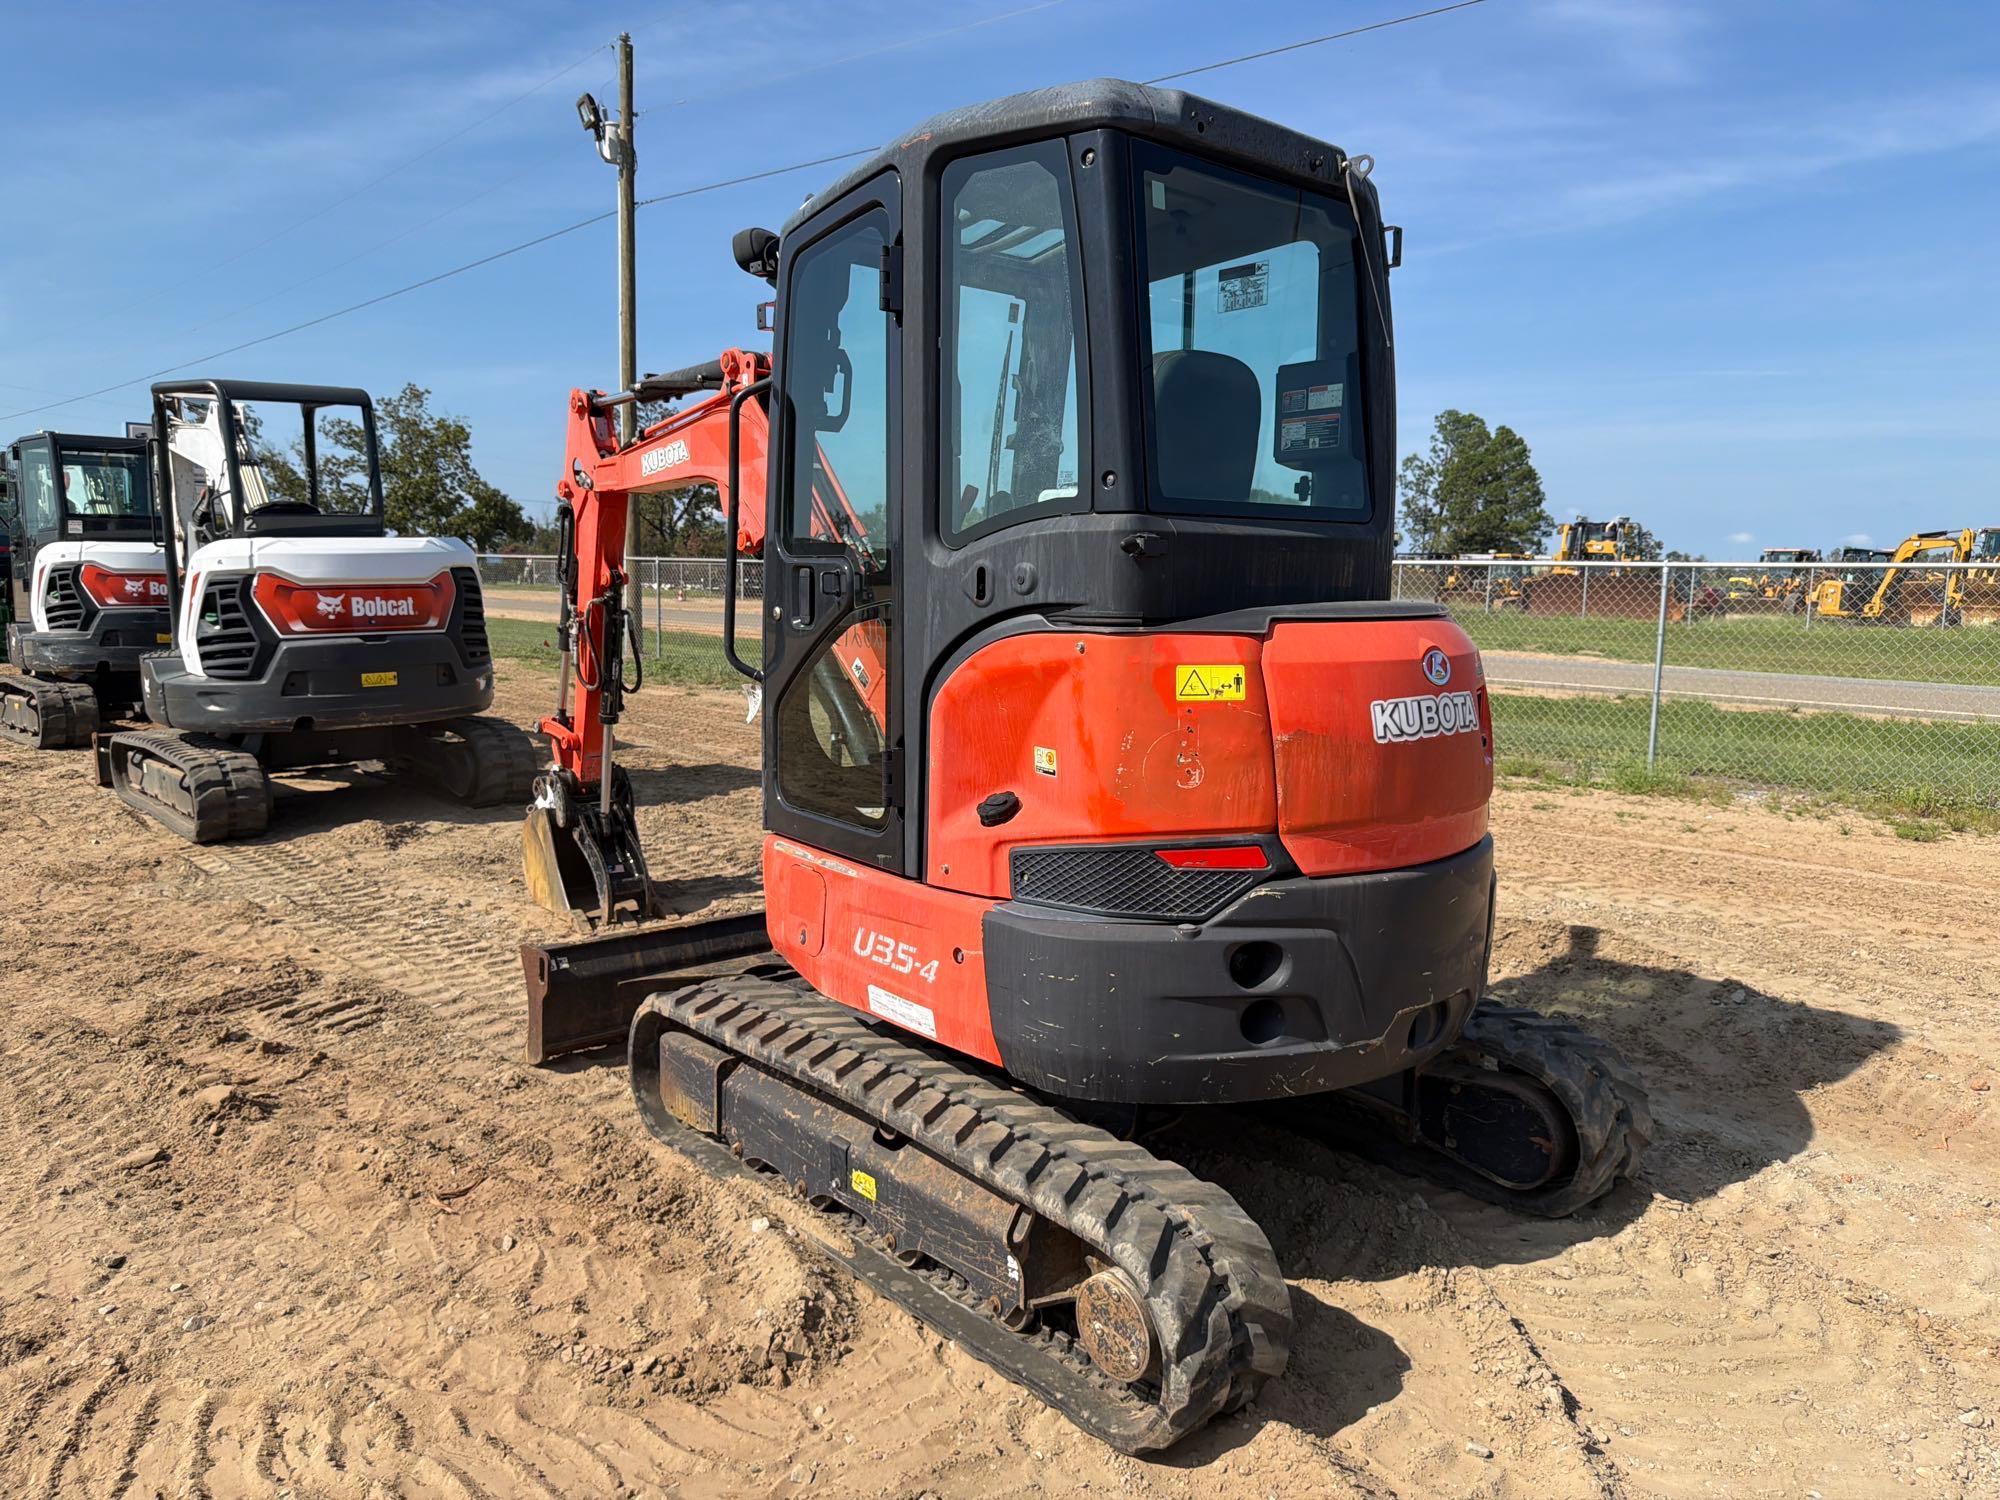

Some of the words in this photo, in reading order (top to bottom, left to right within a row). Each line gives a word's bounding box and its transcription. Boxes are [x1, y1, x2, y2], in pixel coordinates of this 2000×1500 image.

[642, 440, 690, 475] KUBOTA
[149, 581, 168, 596] Bo
[350, 596, 415, 617] Bobcat
[1371, 691, 1478, 742] KUBOTA
[853, 927, 940, 984] U35-4
